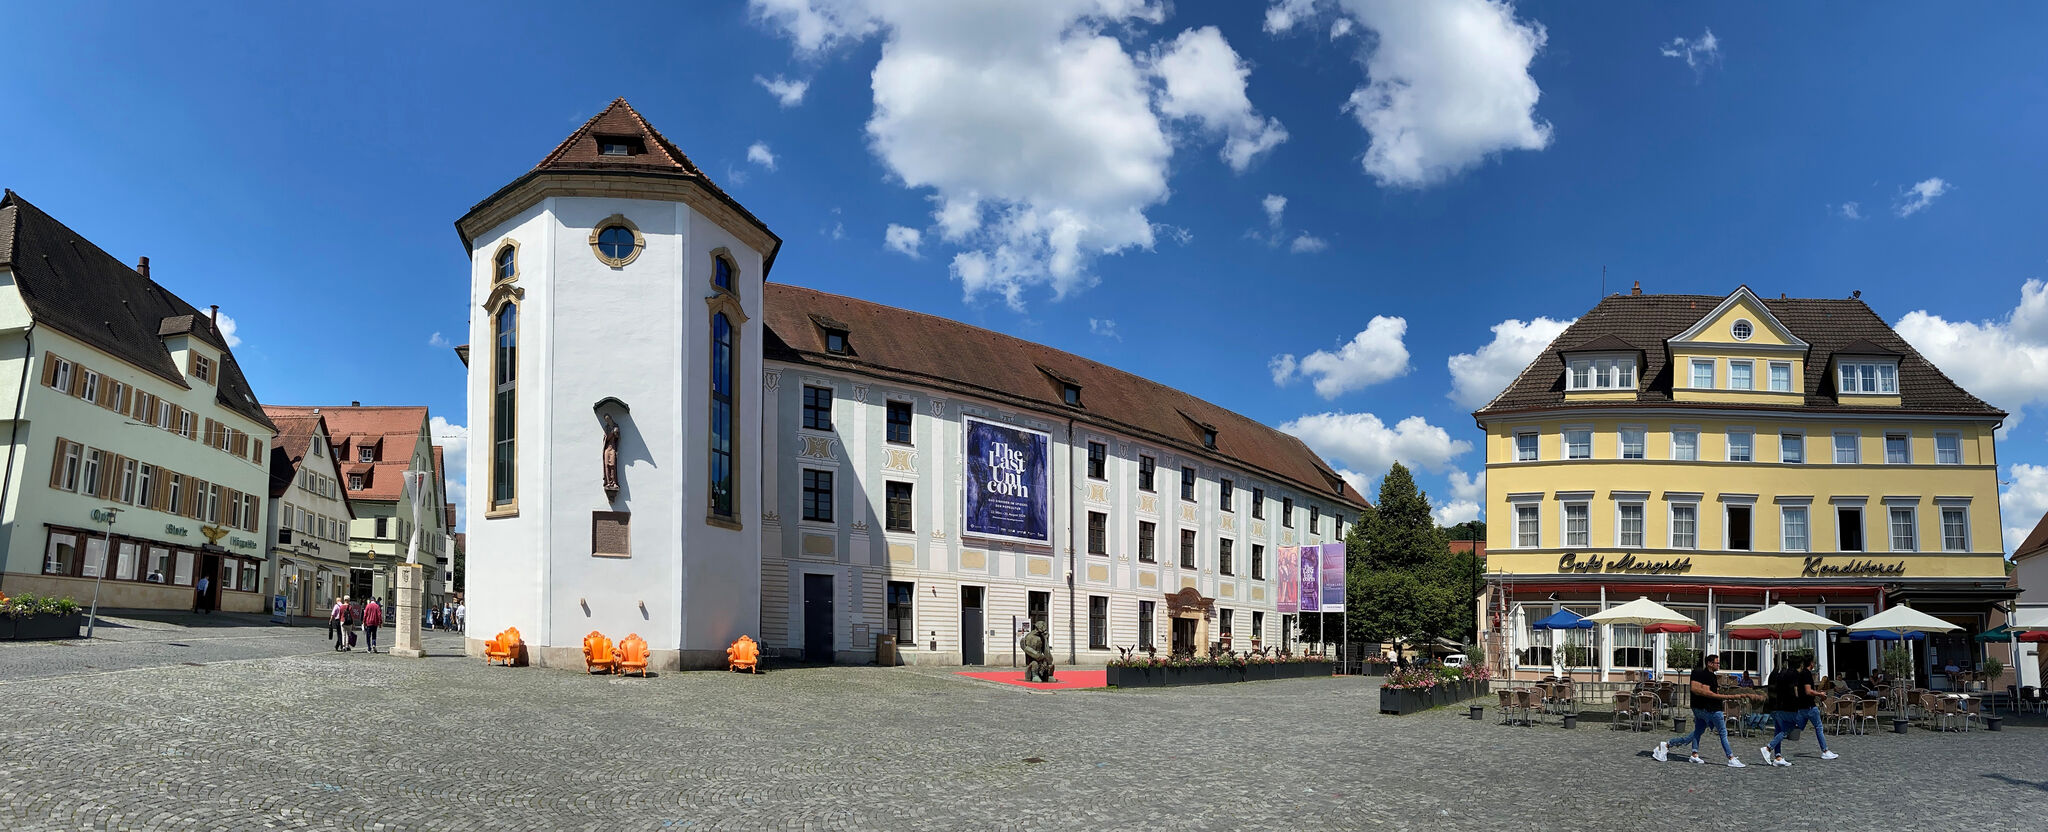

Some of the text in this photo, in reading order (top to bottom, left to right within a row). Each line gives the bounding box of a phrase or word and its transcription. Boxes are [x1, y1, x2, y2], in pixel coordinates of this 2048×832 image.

[992, 442, 1023, 460] The
[989, 451, 1026, 472] Last
[993, 466, 1021, 484] Uni
[987, 481, 1028, 498] corn
[1559, 552, 1692, 574] Café Margrit
[1803, 556, 1906, 575] Konditorei
